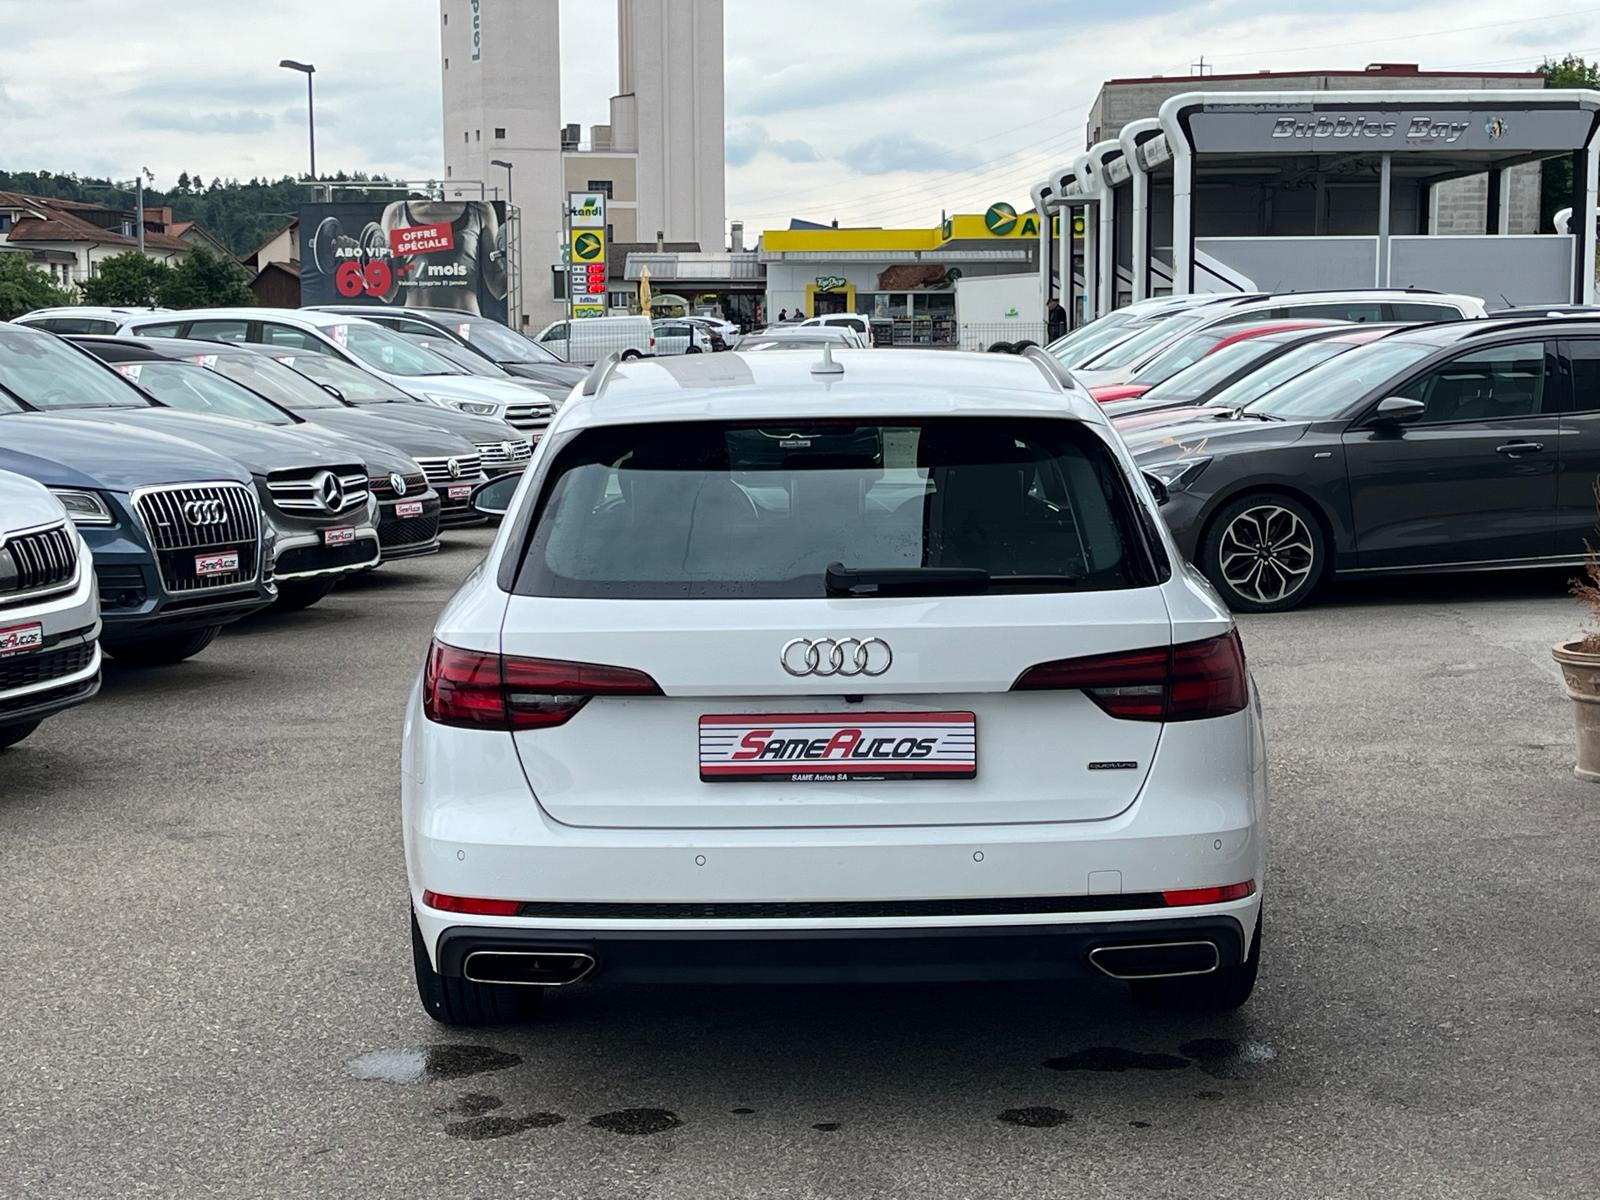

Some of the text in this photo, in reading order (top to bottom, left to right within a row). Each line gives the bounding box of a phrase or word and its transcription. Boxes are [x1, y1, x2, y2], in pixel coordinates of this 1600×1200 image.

[1272, 116, 1471, 143] Bubbles Bay
[402, 228, 437, 241] OFFRE
[397, 237, 449, 253] SPÉCIALE
[335, 247, 363, 258] ABO
[427, 262, 468, 277] mois
[837, 773, 848, 781] SA
